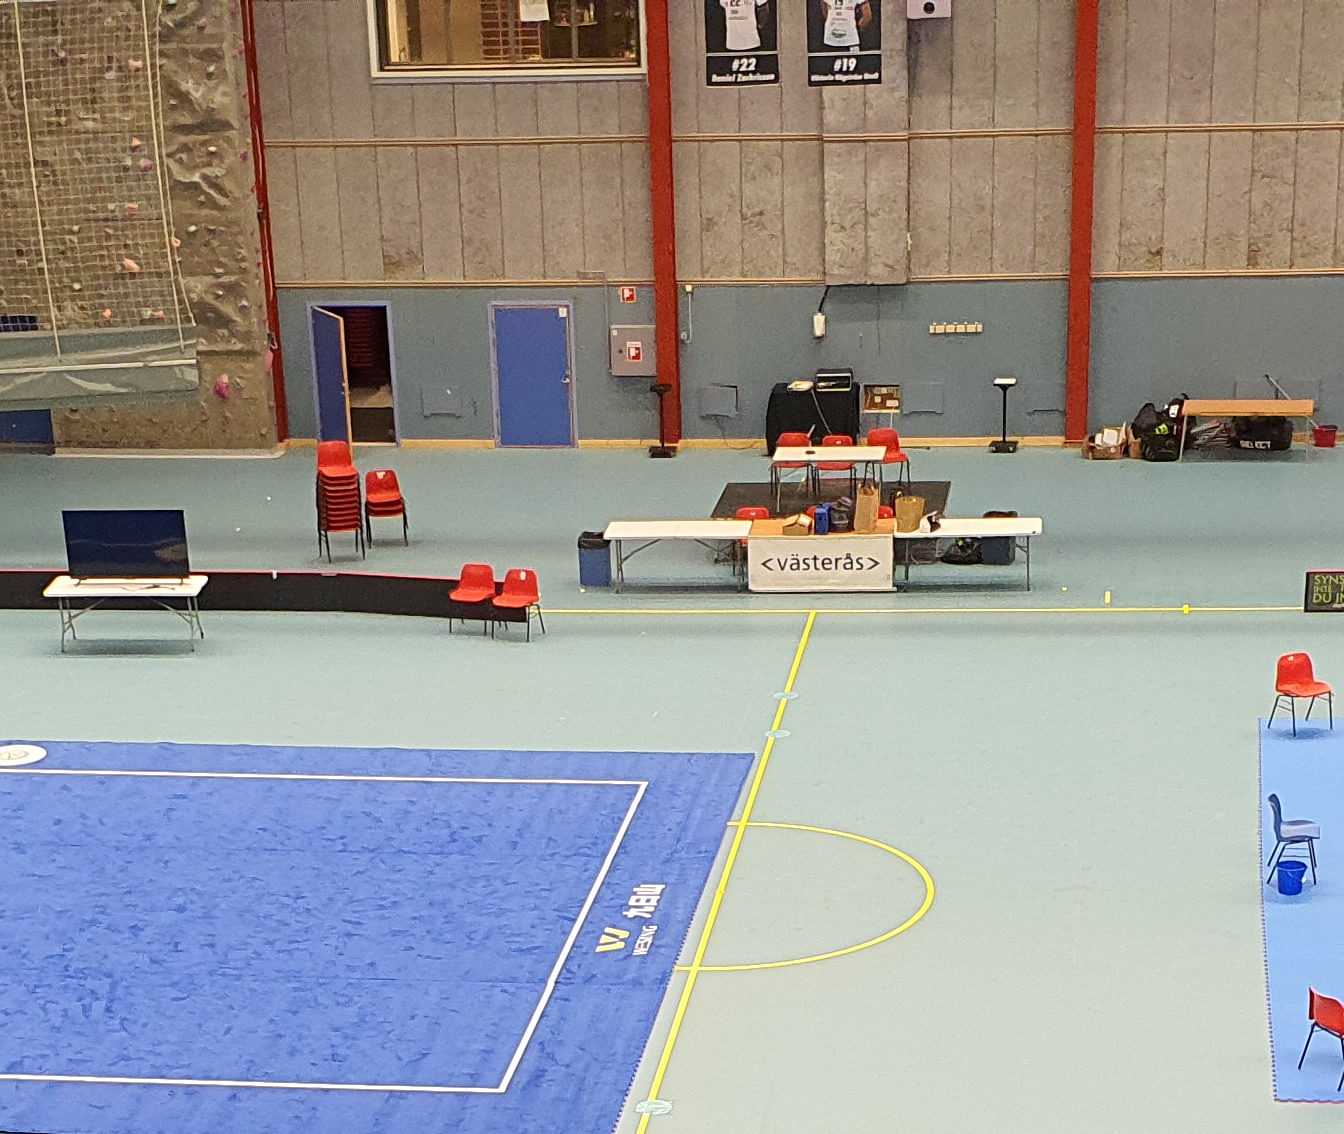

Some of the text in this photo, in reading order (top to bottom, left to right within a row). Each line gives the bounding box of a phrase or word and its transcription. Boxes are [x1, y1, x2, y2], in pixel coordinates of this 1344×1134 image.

[731, 57, 757, 72] #22
[833, 57, 857, 72] #19
[1312, 593, 1333, 603] DU
